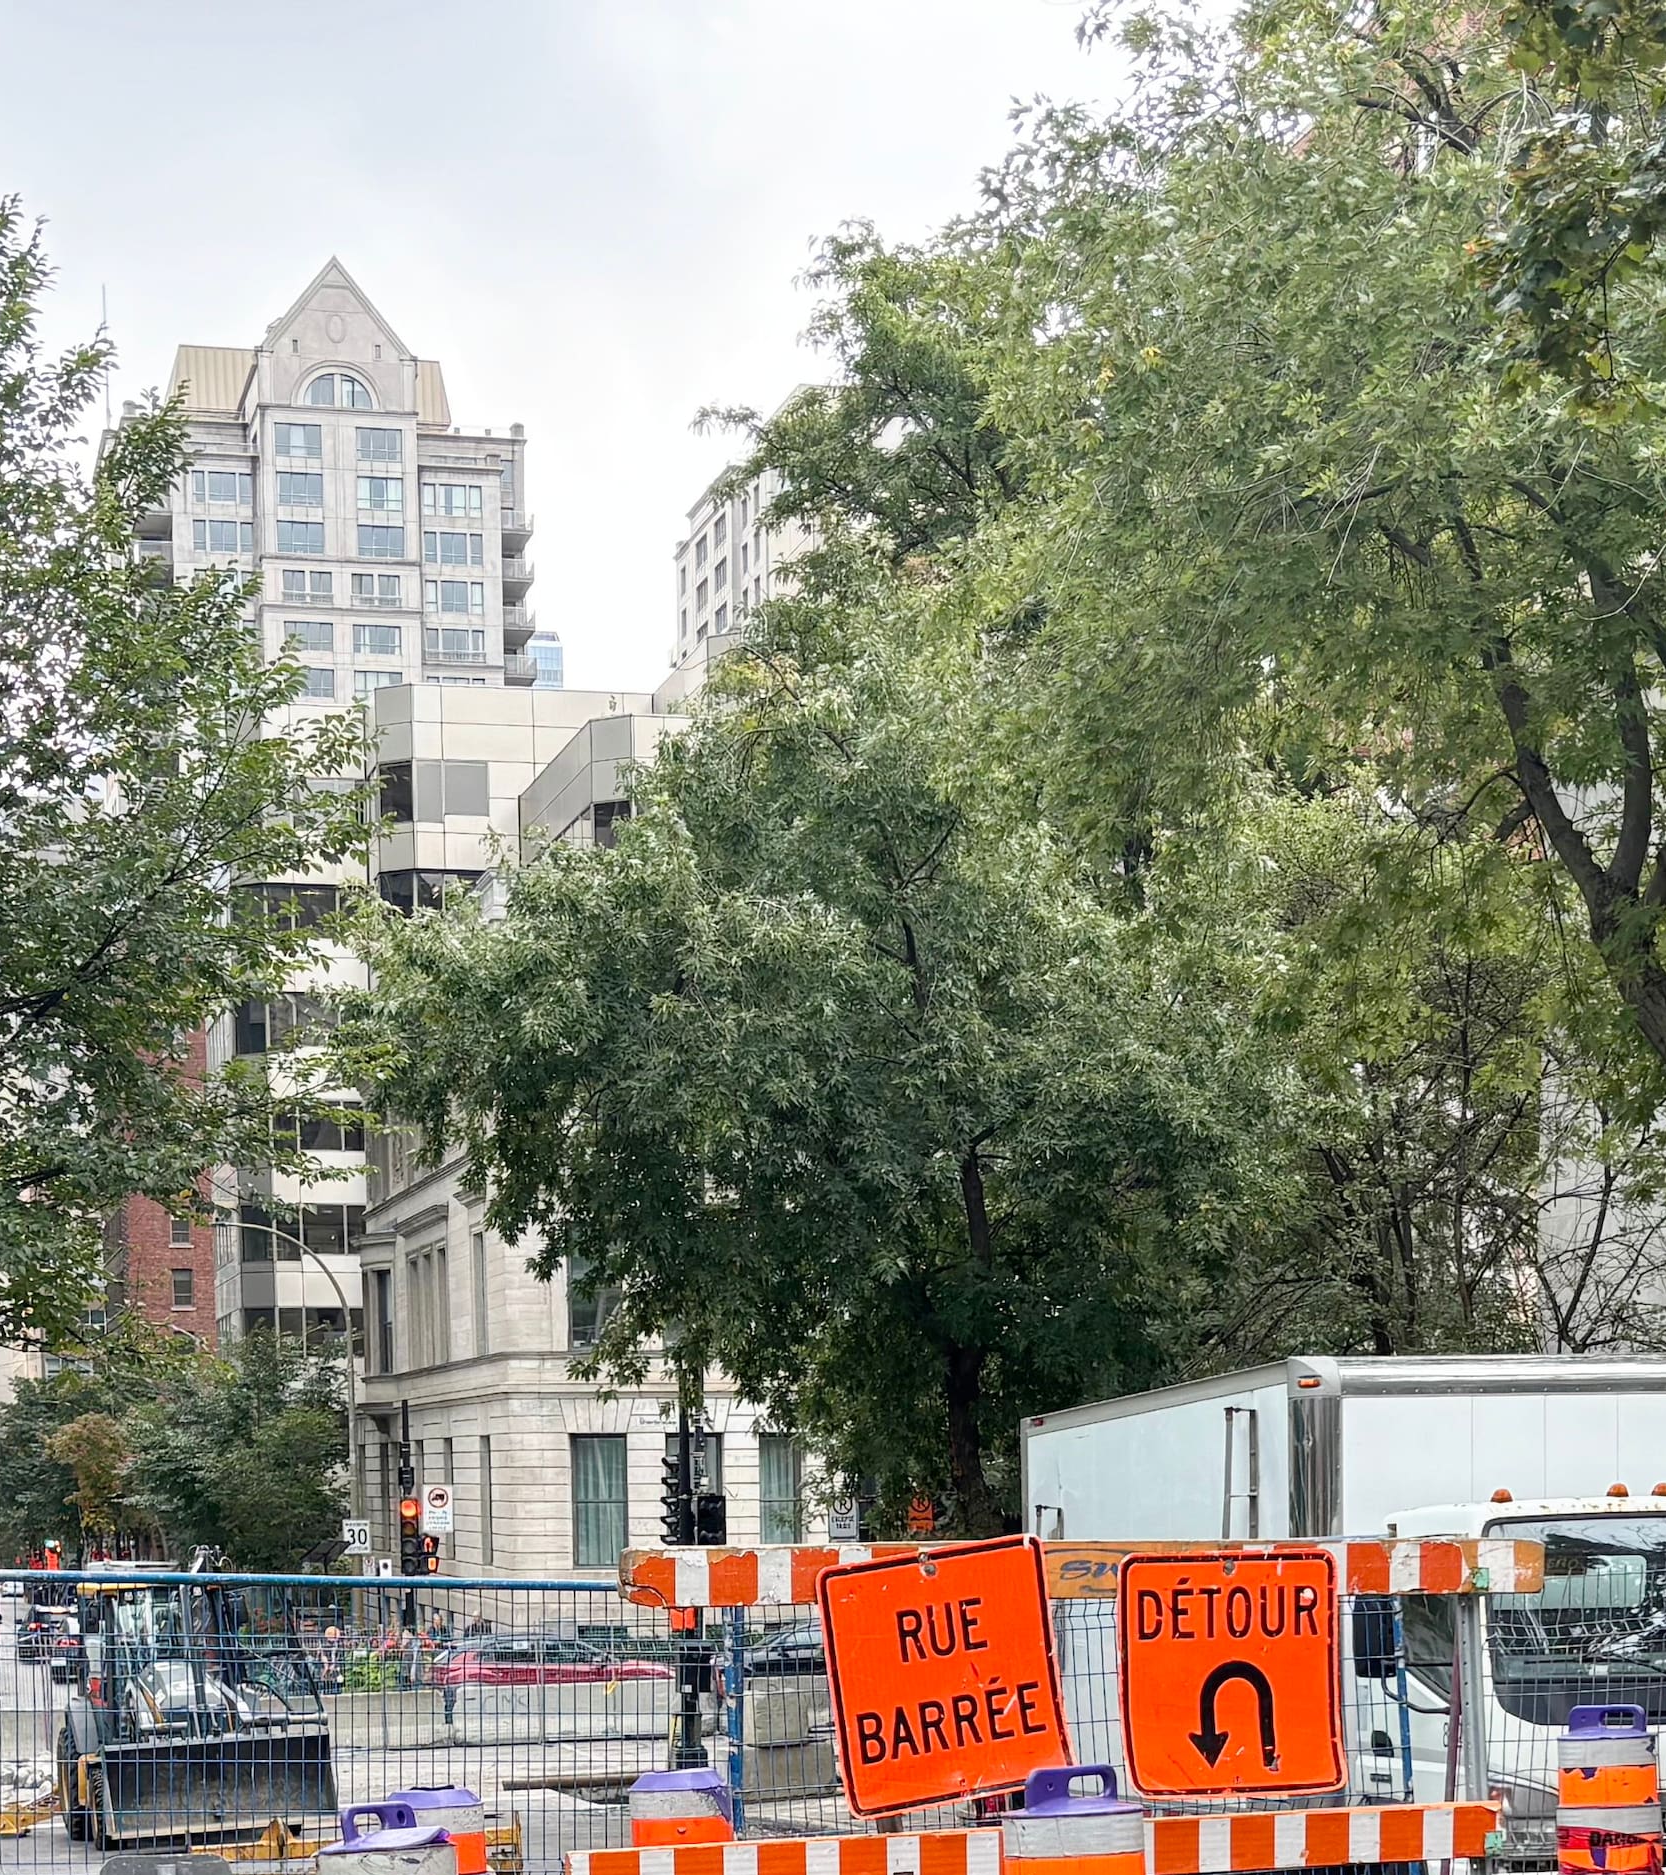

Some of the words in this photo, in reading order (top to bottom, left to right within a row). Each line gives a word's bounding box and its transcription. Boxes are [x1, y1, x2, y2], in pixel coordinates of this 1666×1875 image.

[346, 1528, 368, 1545] 30
[895, 1597, 989, 1663] RUE
[1137, 1576, 1320, 1641] DÉTOUR
[856, 1676, 1048, 1765] BARRÉE
